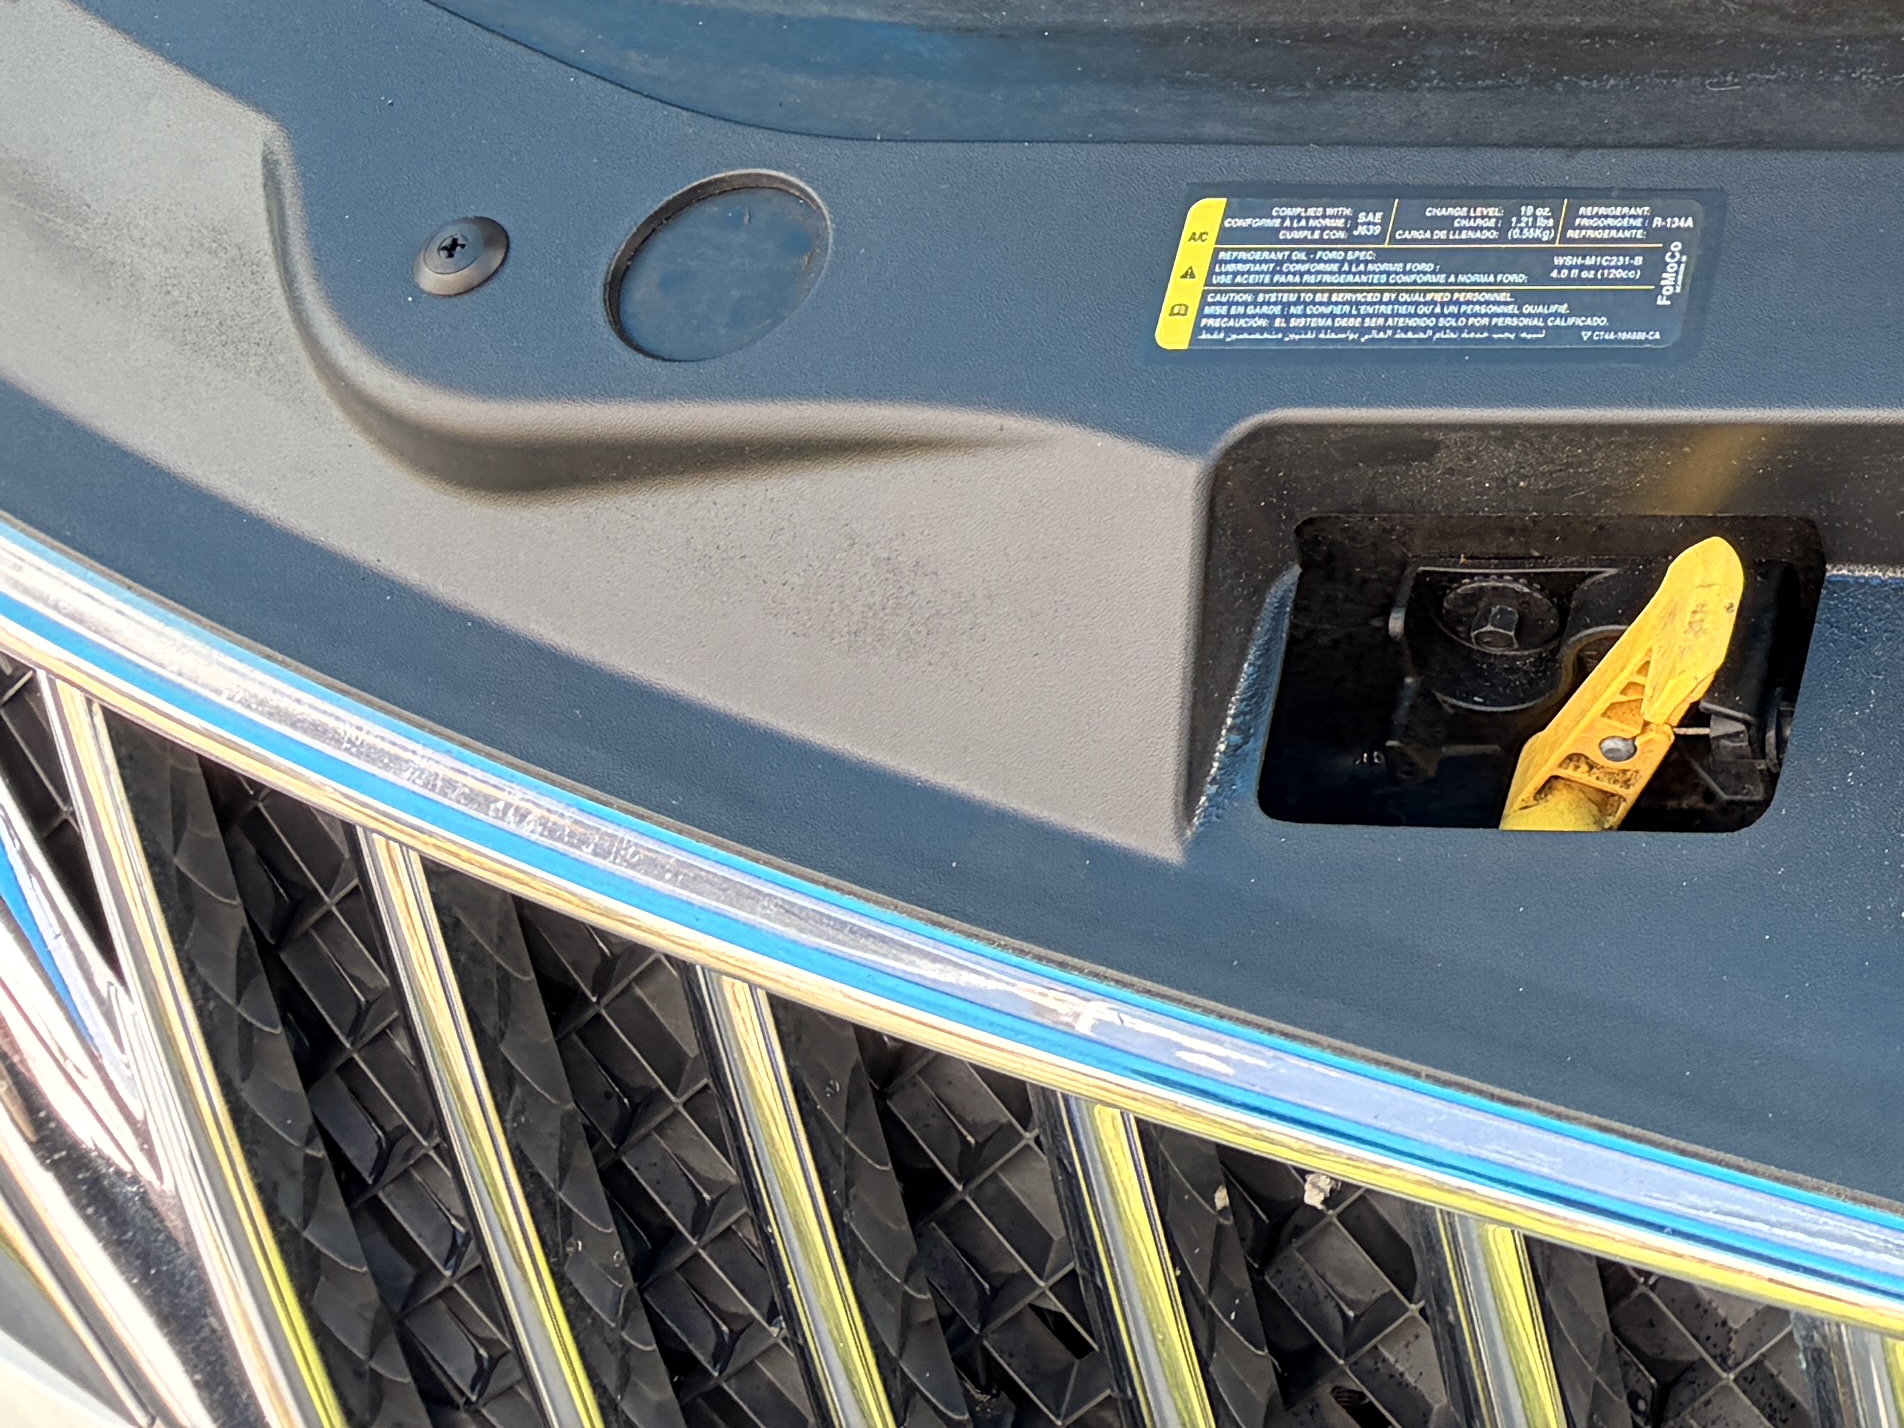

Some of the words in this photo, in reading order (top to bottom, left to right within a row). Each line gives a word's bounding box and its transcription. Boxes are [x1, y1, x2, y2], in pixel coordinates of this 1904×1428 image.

[1272, 207, 1323, 217] COMPLIES
[1425, 206, 1468, 217] CHARGE
[1357, 212, 1383, 223] SAE
[1454, 217, 1498, 227] CHARGE
[1293, 218, 1307, 228] LA
[1652, 217, 1694, 229] R-134A
[1188, 231, 1208, 242] A/C
[1315, 251, 1344, 260] FORD
[1405, 262, 1434, 272] FORD
[1656, 240, 1682, 306] FoMoCo
[1212, 274, 1233, 284] USE
[1272, 274, 1301, 284] PARA
[1300, 292, 1313, 302] TO
[1315, 292, 1329, 302] BE
[1383, 292, 1397, 302] BY
